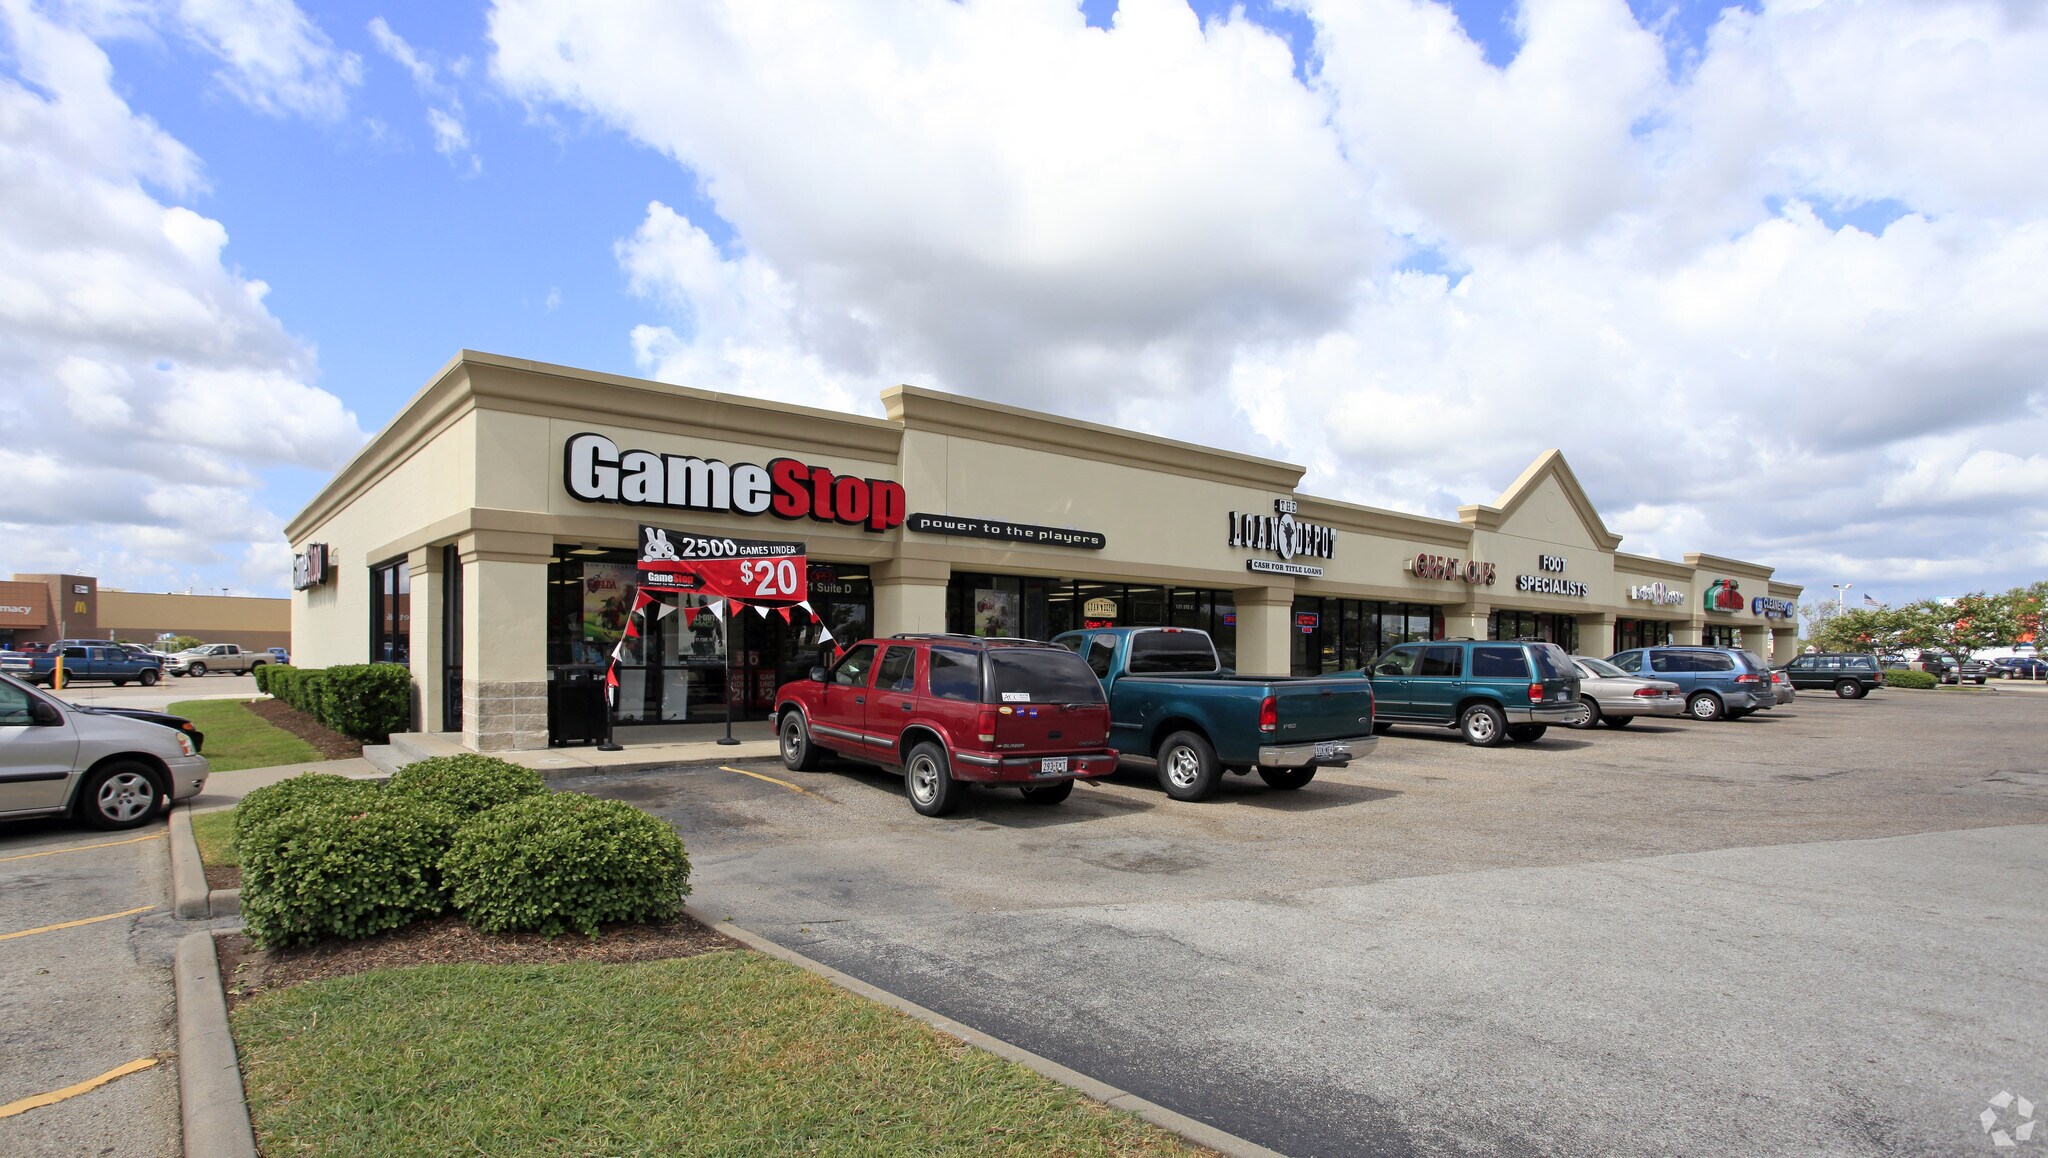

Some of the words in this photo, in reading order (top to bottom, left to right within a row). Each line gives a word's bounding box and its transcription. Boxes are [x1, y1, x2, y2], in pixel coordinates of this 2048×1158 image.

[569, 434, 905, 530] GameStop
[1281, 500, 1296, 512] THE
[920, 518, 977, 531] power
[983, 523, 1001, 534] to
[1006, 526, 1034, 537] the
[1039, 530, 1099, 544] players
[1233, 511, 1279, 551] LOAN
[1296, 521, 1337, 559] DEPOT
[682, 537, 738, 557] 2500
[739, 545, 769, 555] GAMES
[770, 545, 797, 555] UNDER
[1253, 561, 1270, 569] CASH
[1271, 563, 1284, 571] FOR
[1285, 565, 1303, 573] TITLE
[1303, 567, 1322, 575] LOANS
[1416, 553, 1459, 581] GREAT
[1464, 560, 1497, 586] CLIPS
[1543, 555, 1568, 572] FOOT
[648, 572, 694, 584] GameStop
[740, 559, 798, 596] $20
[1520, 575, 1588, 597] SPECIALISTS
[817, 582, 842, 593] Suite
[844, 584, 852, 594] D
[0, 606, 31, 615] macy
